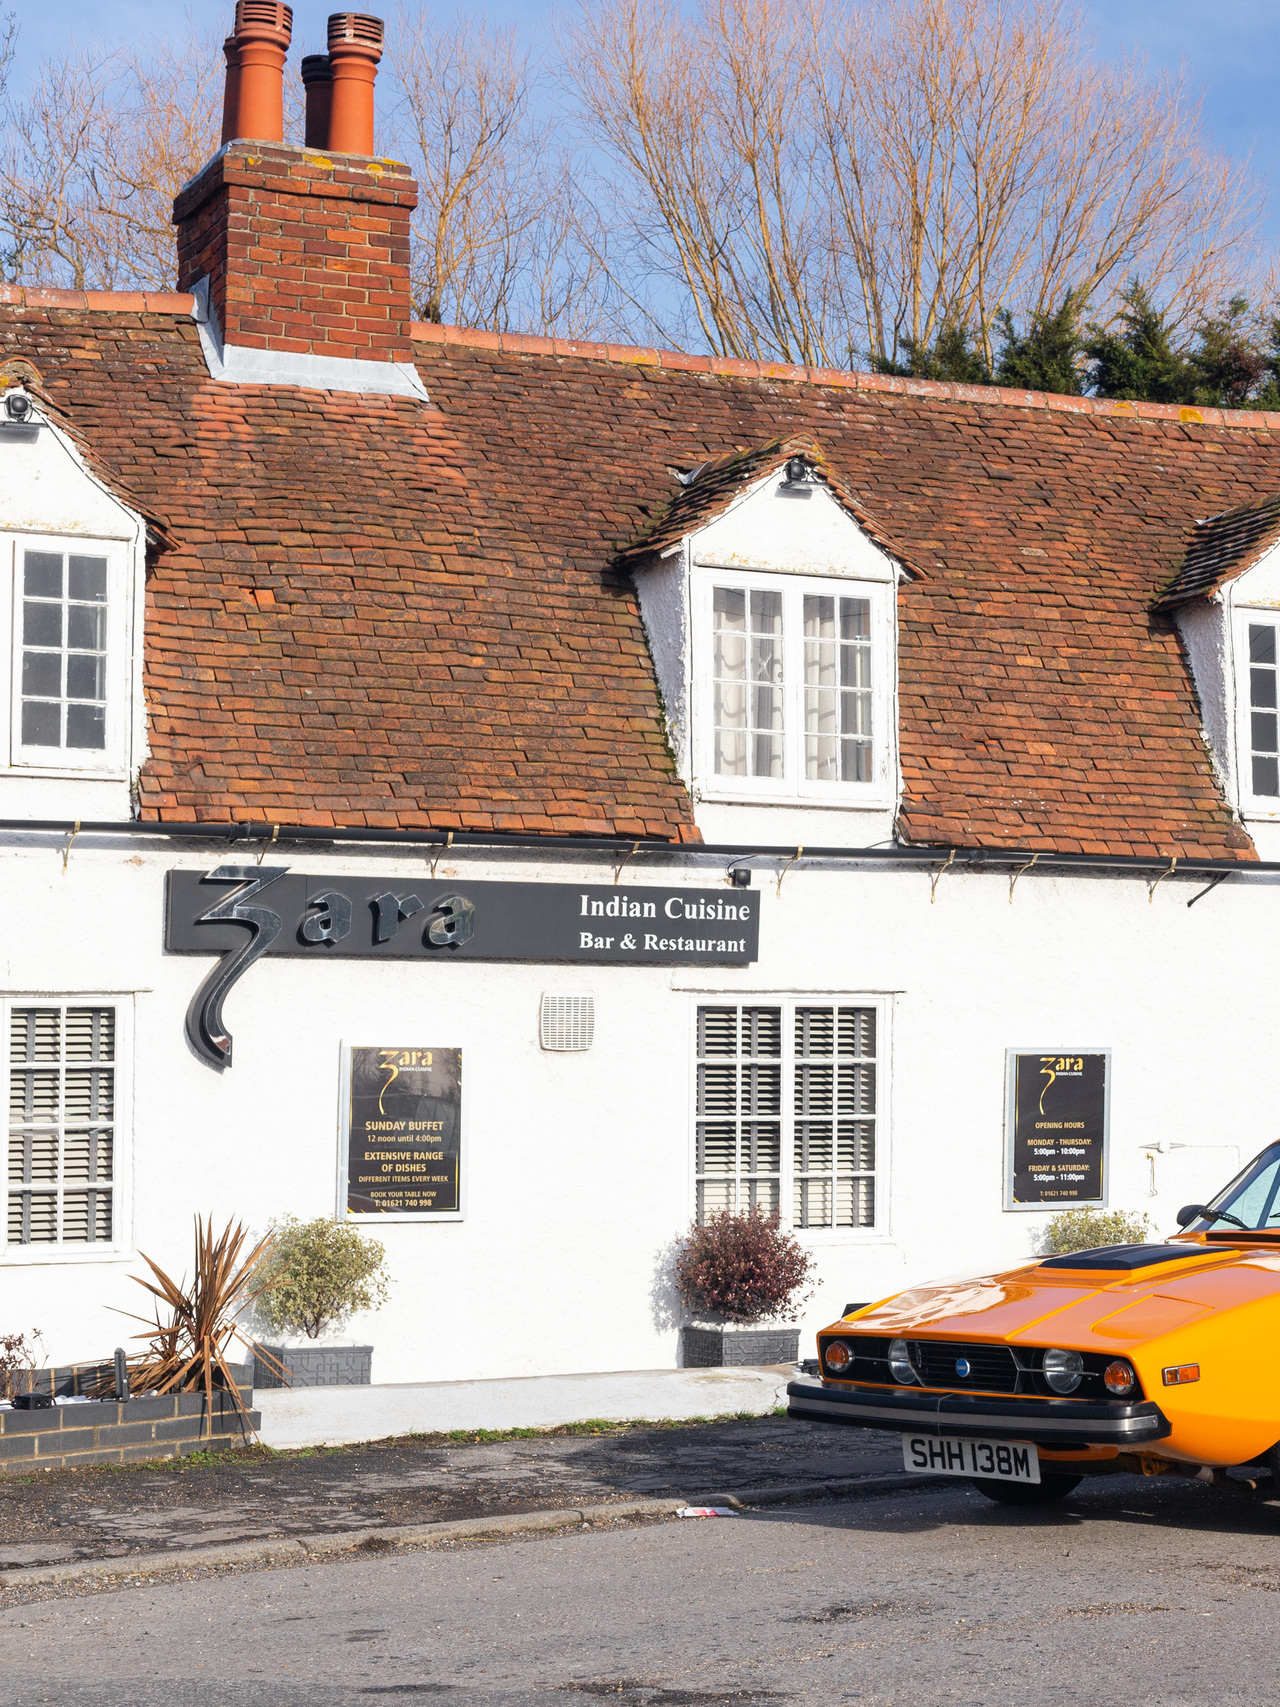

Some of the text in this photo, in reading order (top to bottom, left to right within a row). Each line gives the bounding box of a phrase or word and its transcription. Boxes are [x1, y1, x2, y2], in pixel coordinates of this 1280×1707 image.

[580, 895, 750, 921] Indian Cuisine
[579, 932, 746, 952] Bar & Restaurant
[365, 1121, 443, 1130] SUNDAY BUFFET
[415, 1135, 441, 1144] 4:00pm
[365, 1152, 443, 1160] EXTENSIVE RANGE
[1034, 1148, 1055, 1156] 5:00pm
[1061, 1148, 1085, 1156] 10:00pm
[382, 1164, 426, 1172] OF DISHES
[1034, 1174, 1055, 1182] 5:00pm
[1060, 1174, 1084, 1182] 11:00pm
[911, 1439, 1030, 1478] SHH 138M
